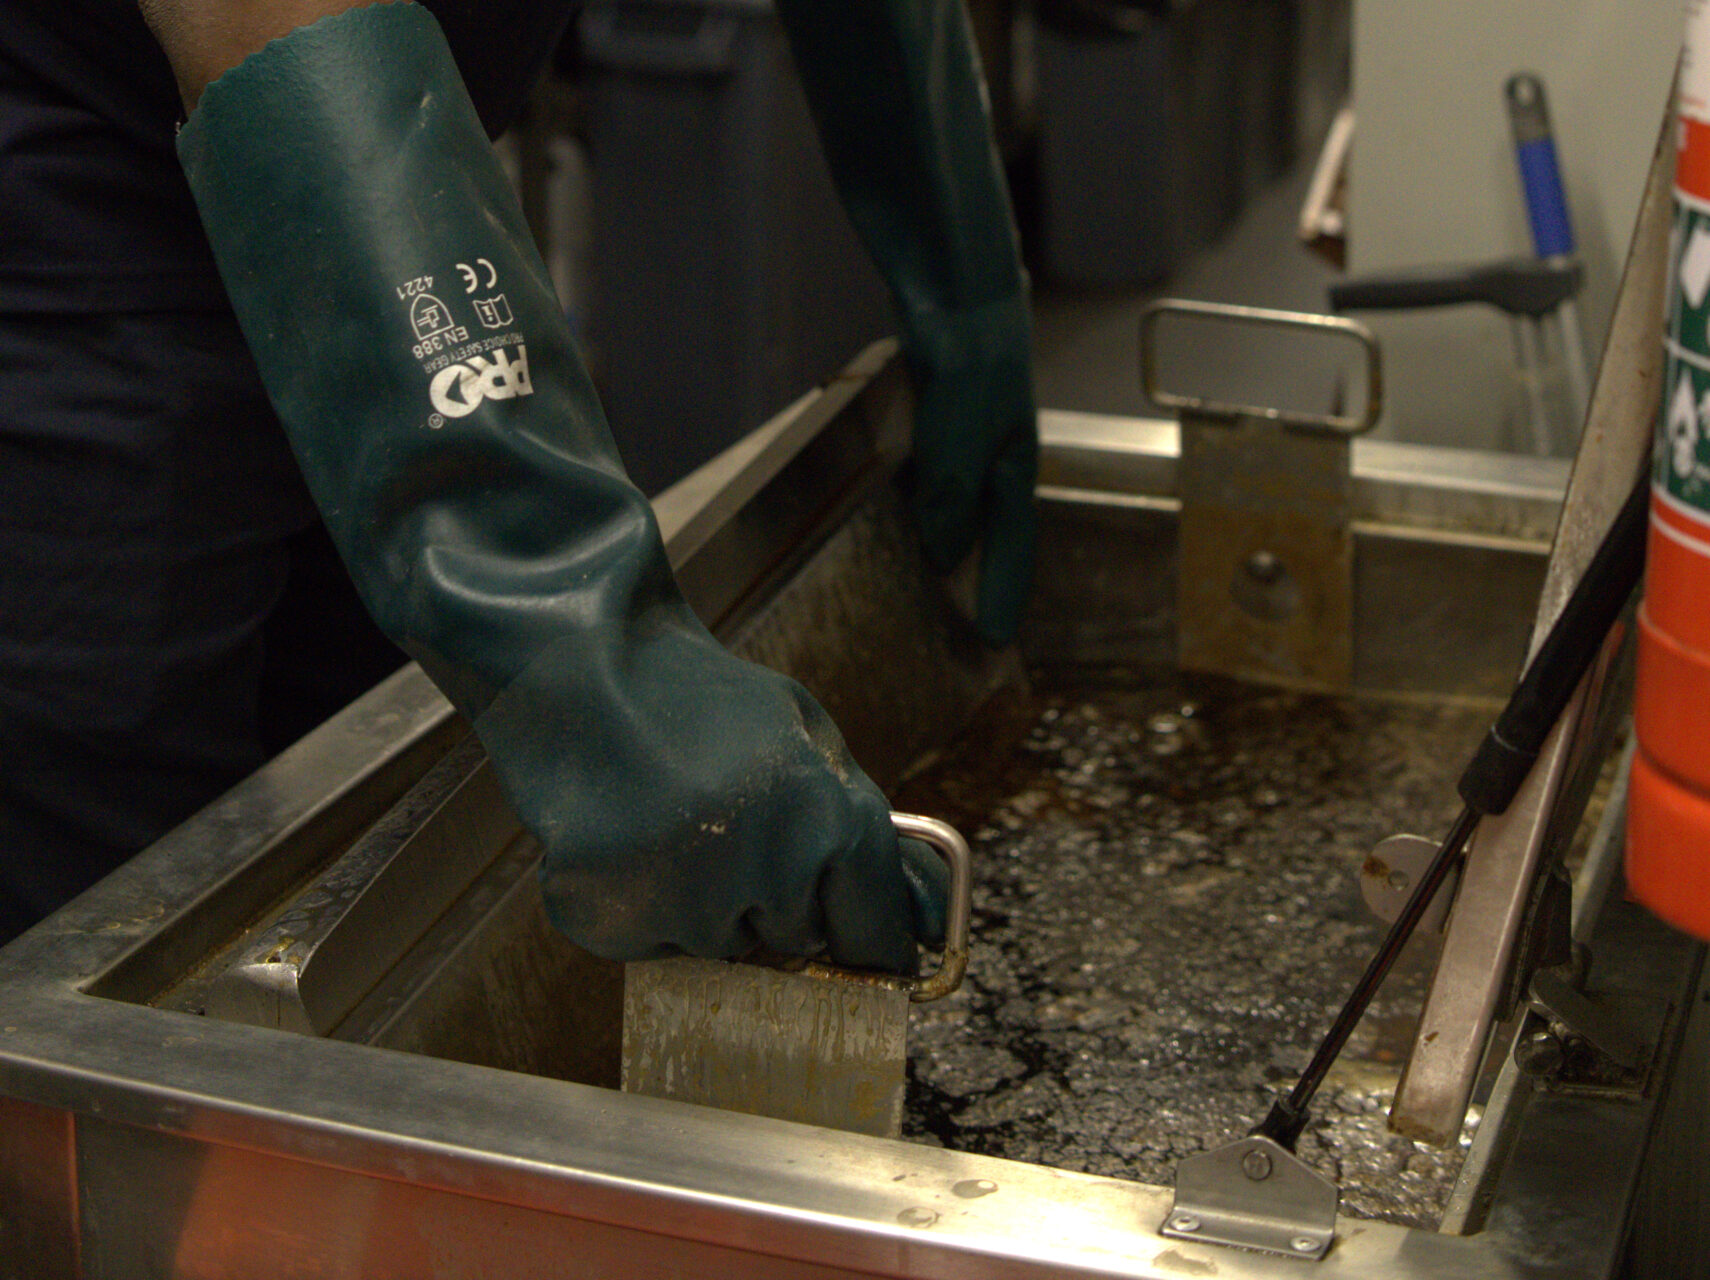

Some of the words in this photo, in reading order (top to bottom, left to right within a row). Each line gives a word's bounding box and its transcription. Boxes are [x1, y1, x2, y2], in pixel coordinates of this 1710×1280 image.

[396, 275, 433, 301] 4221
[444, 326, 470, 346] EN
[485, 333, 512, 351] CHOICE
[412, 336, 443, 360] 388
[451, 341, 484, 362] SAFETY
[424, 356, 450, 374] GEAR
[429, 344, 534, 418] PRO
